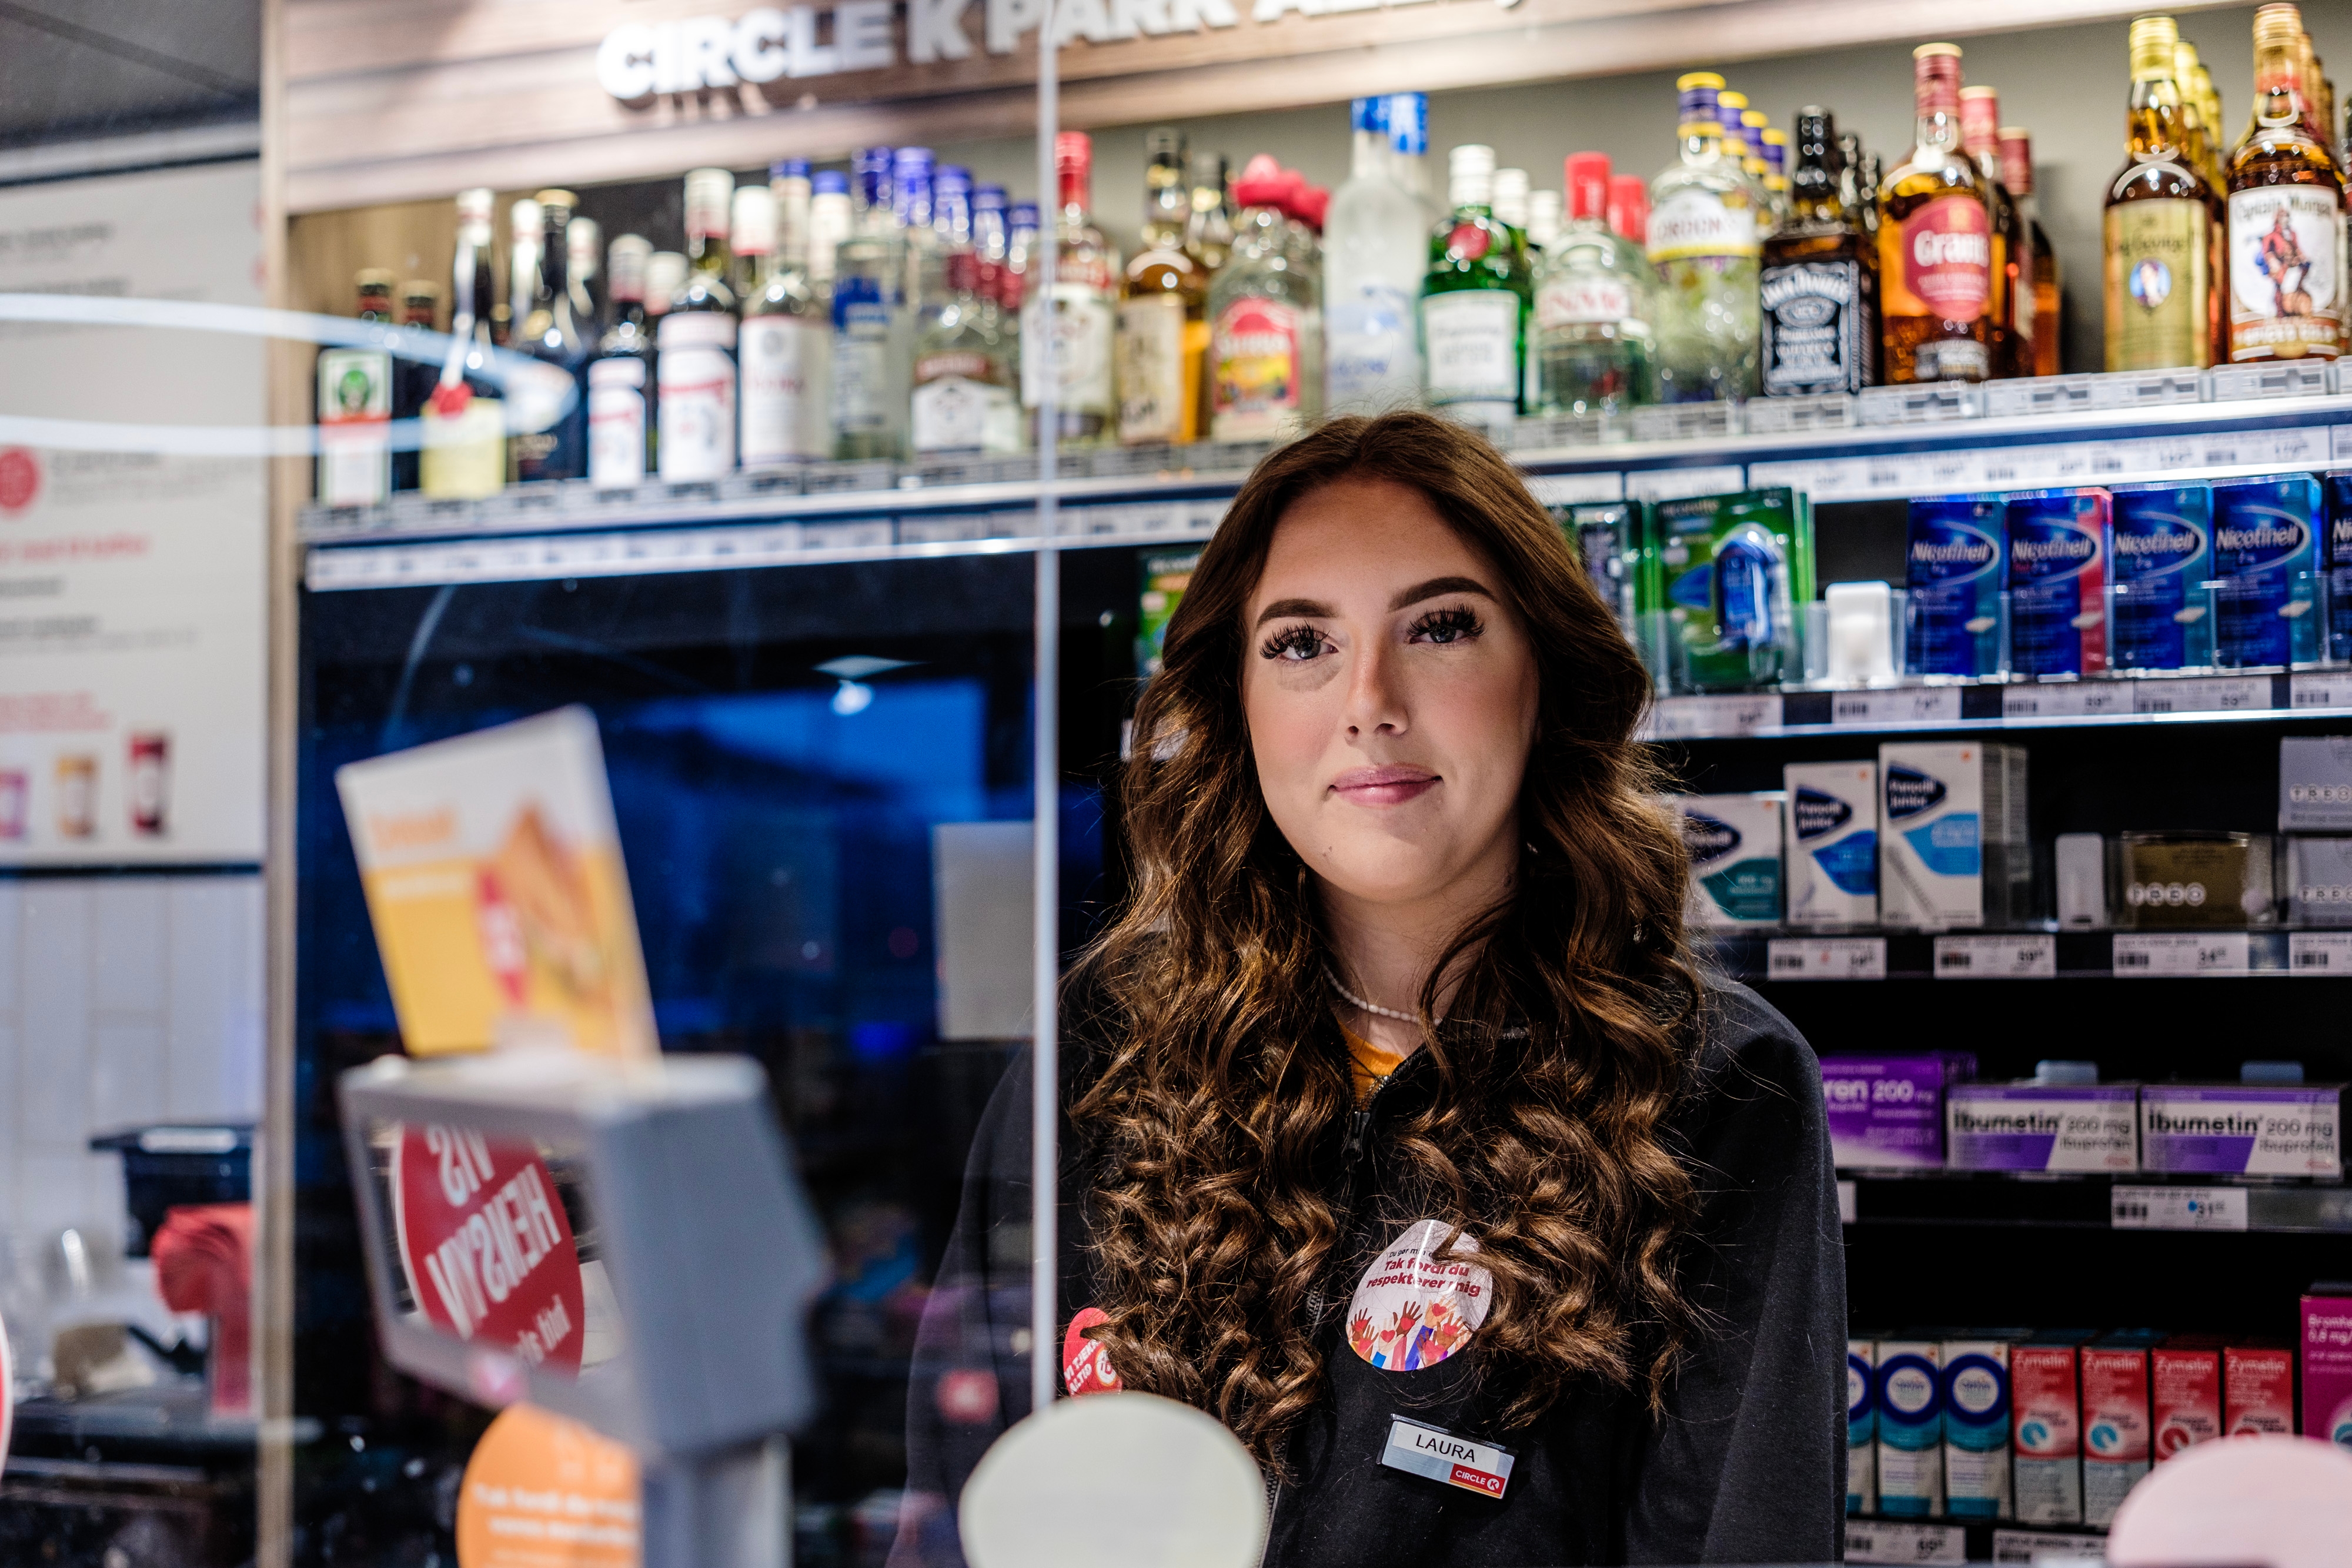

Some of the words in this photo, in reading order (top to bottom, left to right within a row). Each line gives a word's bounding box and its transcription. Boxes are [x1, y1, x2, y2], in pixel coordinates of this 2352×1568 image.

[597, 4, 894, 99] CIRCLE
[907, 0, 971, 63] K
[2012, 536, 2091, 560] Nicotinell
[2115, 530, 2196, 555] Nicotinell
[2216, 524, 2298, 551] Nicotinell
[1912, 539, 1990, 561] Nicotinell
[1823, 1079, 1869, 1101] ren
[1872, 1079, 1915, 1103] 200
[1954, 1111, 2059, 1131] Ibumetin
[2148, 1111, 2259, 1132] Ibumetin
[2266, 1118, 2301, 1136] 200
[2305, 1121, 2334, 1140] mg
[1398, 1248, 1409, 1257] gør
[1384, 1258, 1405, 1271] Tak
[1406, 1258, 1446, 1275] fordi
[1448, 1265, 1471, 1276] du
[1366, 1272, 1446, 1288] respekterer
[1448, 1281, 1481, 1297] mig
[1064, 1365, 1074, 1381] VI
[2157, 1356, 2213, 1375] Zymelin
[2229, 1355, 2286, 1375] Zymelin
[1416, 1434, 1475, 1463] LAURA
[1455, 1470, 1486, 1485] CIRCLE
[1487, 1478, 1499, 1490] K
